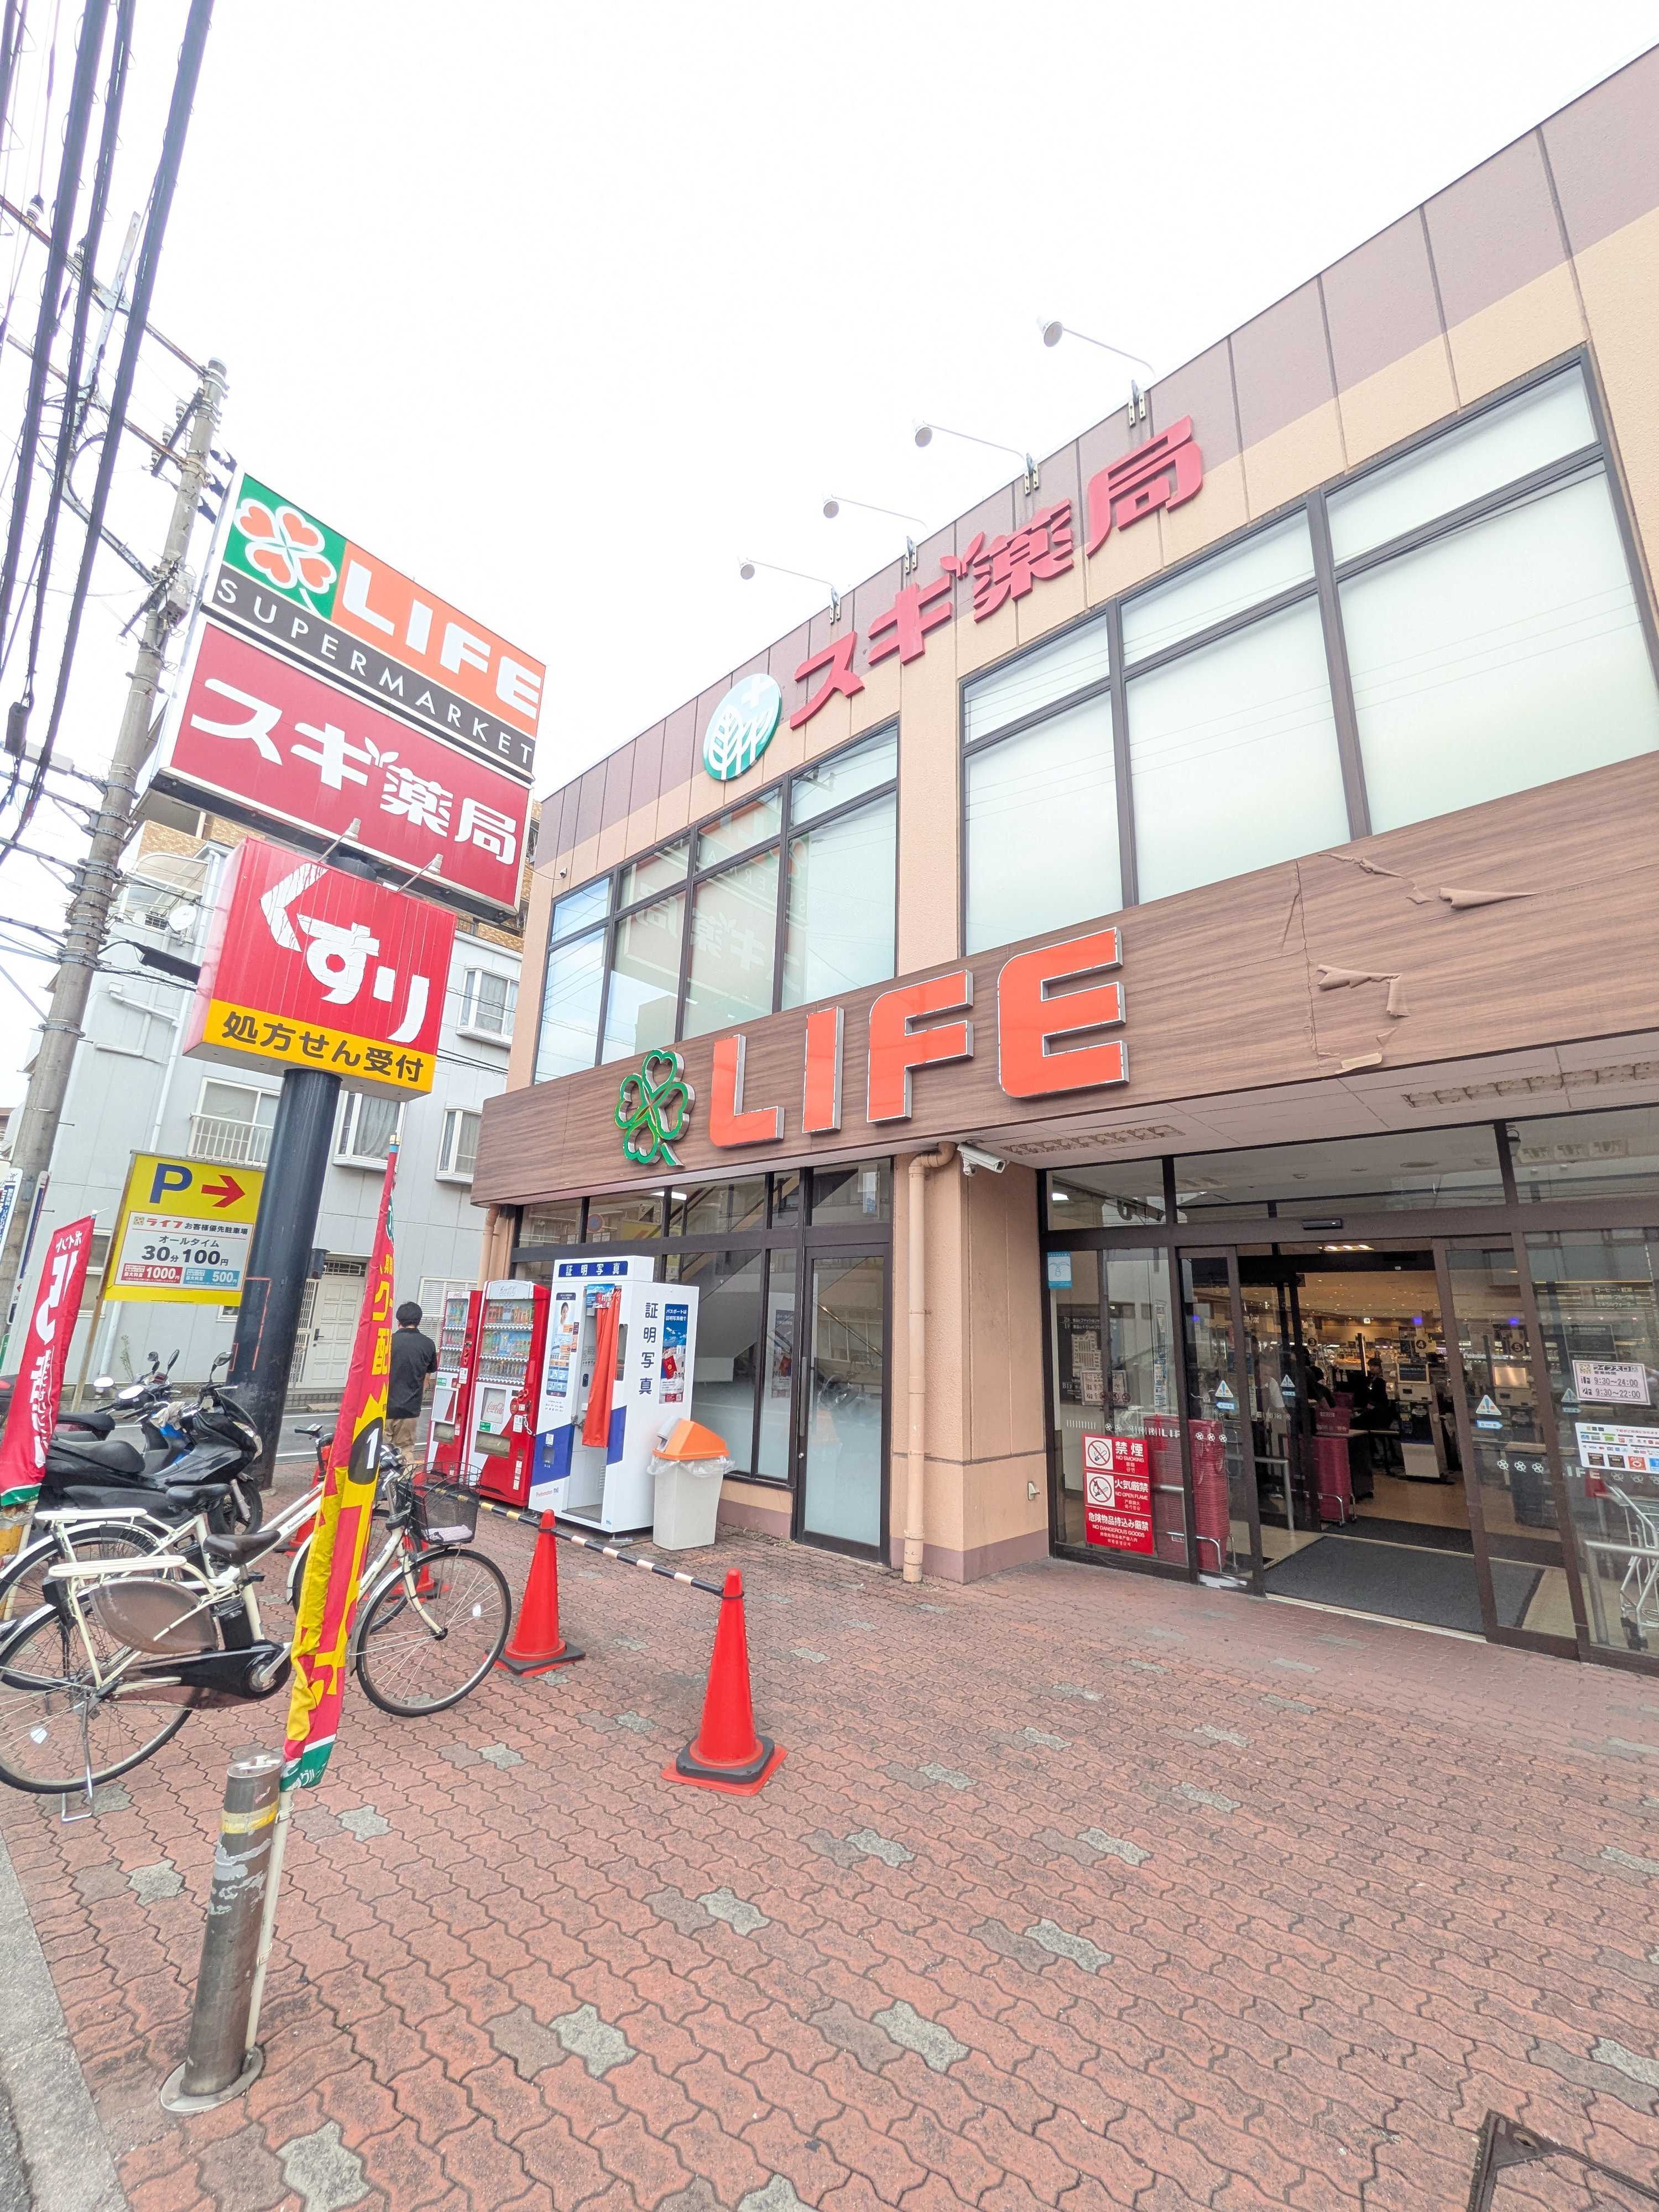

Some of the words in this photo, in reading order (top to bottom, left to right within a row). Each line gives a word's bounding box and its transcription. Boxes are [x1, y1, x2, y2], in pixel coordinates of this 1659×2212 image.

[789, 415, 1203, 730] スギ薬局
[342, 559, 542, 718] LIFE
[217, 577, 533, 765] SUPERMARKET
[190, 677, 517, 864] スギ薬局
[259, 862, 430, 1044] くすり
[222, 1010, 425, 1083] 処方せん受付
[708, 926, 1130, 1149] LIFE
[149, 1162, 193, 1204] P
[147, 1218, 184, 1229] ライフ
[184, 1223, 248, 1235] お客様優先駐車場
[159, 1235, 220, 1248] オールタイム
[142, 1245, 179, 1263] 30分
[182, 1249, 229, 1266] 100円
[565, 1262, 622, 1276] 証明写真
[146, 1267, 180, 1280] 1000円
[212, 1271, 238, 1284] 500円
[638, 1302, 659, 1395] 証明写真
[366, 1427, 380, 1469] 1
[1115, 1441, 1144, 1457] 禁煙
[1114, 1478, 1149, 1493] 火気厳禁
[1088, 1512, 1149, 1532] 危険物品持込み厳禁
[1100, 1525, 1128, 1535] DANGEROUS
[1128, 1528, 1145, 1538] GOODS
